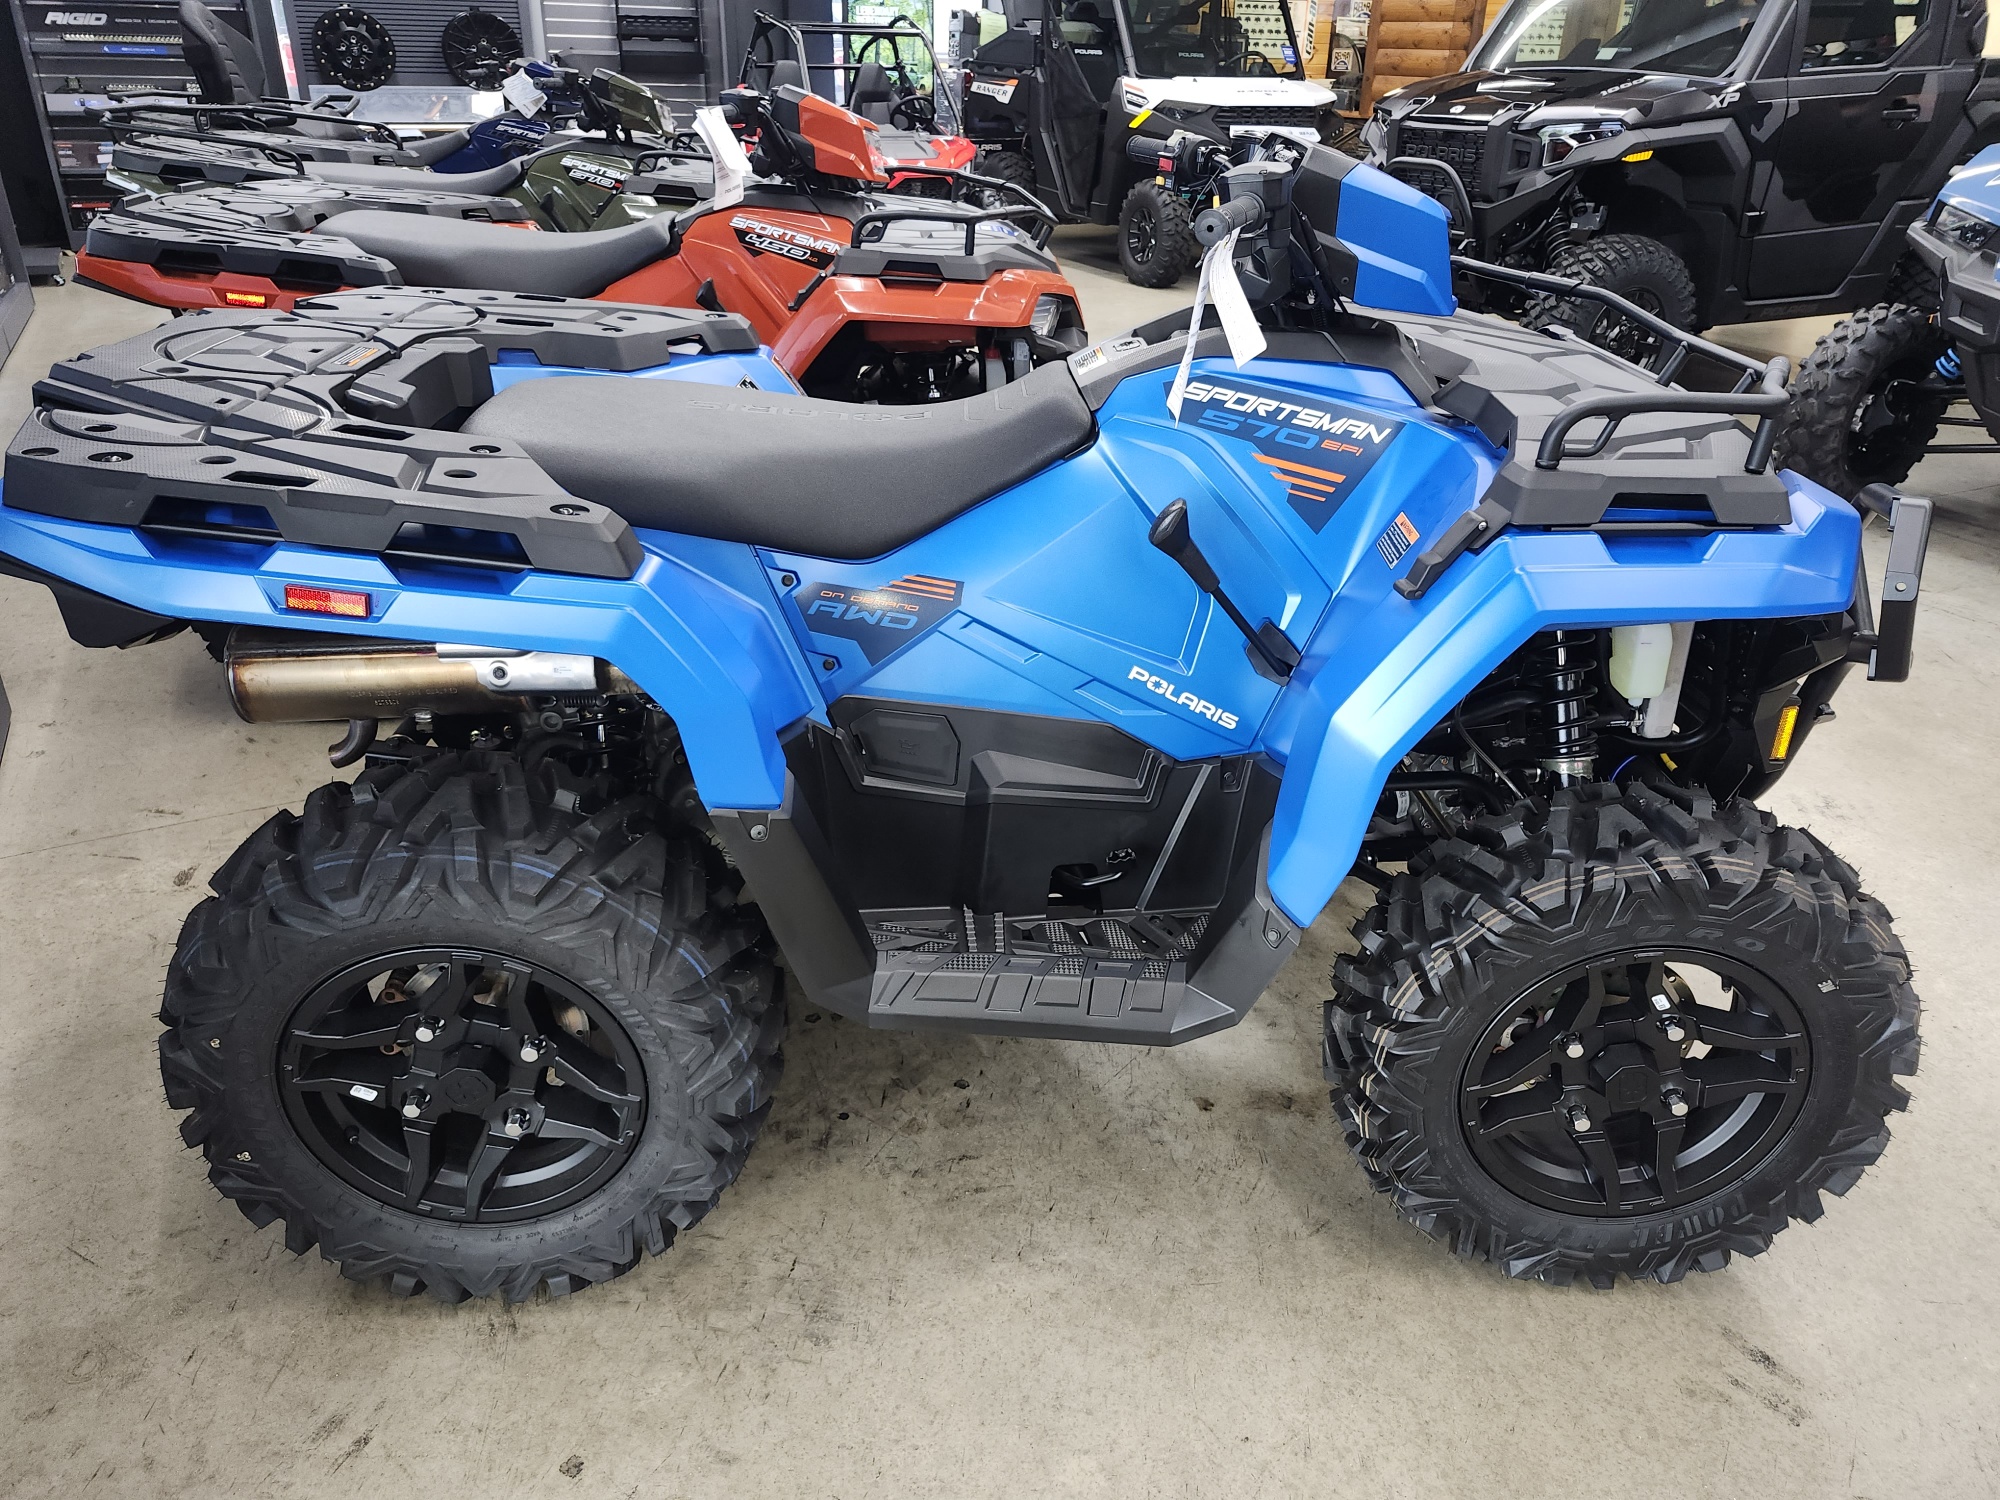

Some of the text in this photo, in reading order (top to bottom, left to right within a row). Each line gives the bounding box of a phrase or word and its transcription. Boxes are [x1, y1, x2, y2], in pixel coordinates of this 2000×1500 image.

[44, 11, 108, 25] RIGID
[1074, 48, 1103, 56] POLARIS
[975, 84, 1008, 97] RANGER
[1599, 77, 1645, 97] 1000
[1706, 91, 1741, 110] XP
[1405, 143, 1477, 163] POLARIS
[728, 216, 841, 254] SPORTSMAN
[745, 233, 810, 260] 450
[1183, 381, 1393, 444] SPORTSMAN
[1197, 408, 1364, 457] 570 EFI
[807, 599, 919, 630] AWD
[1127, 665, 1240, 731] POLARIS
